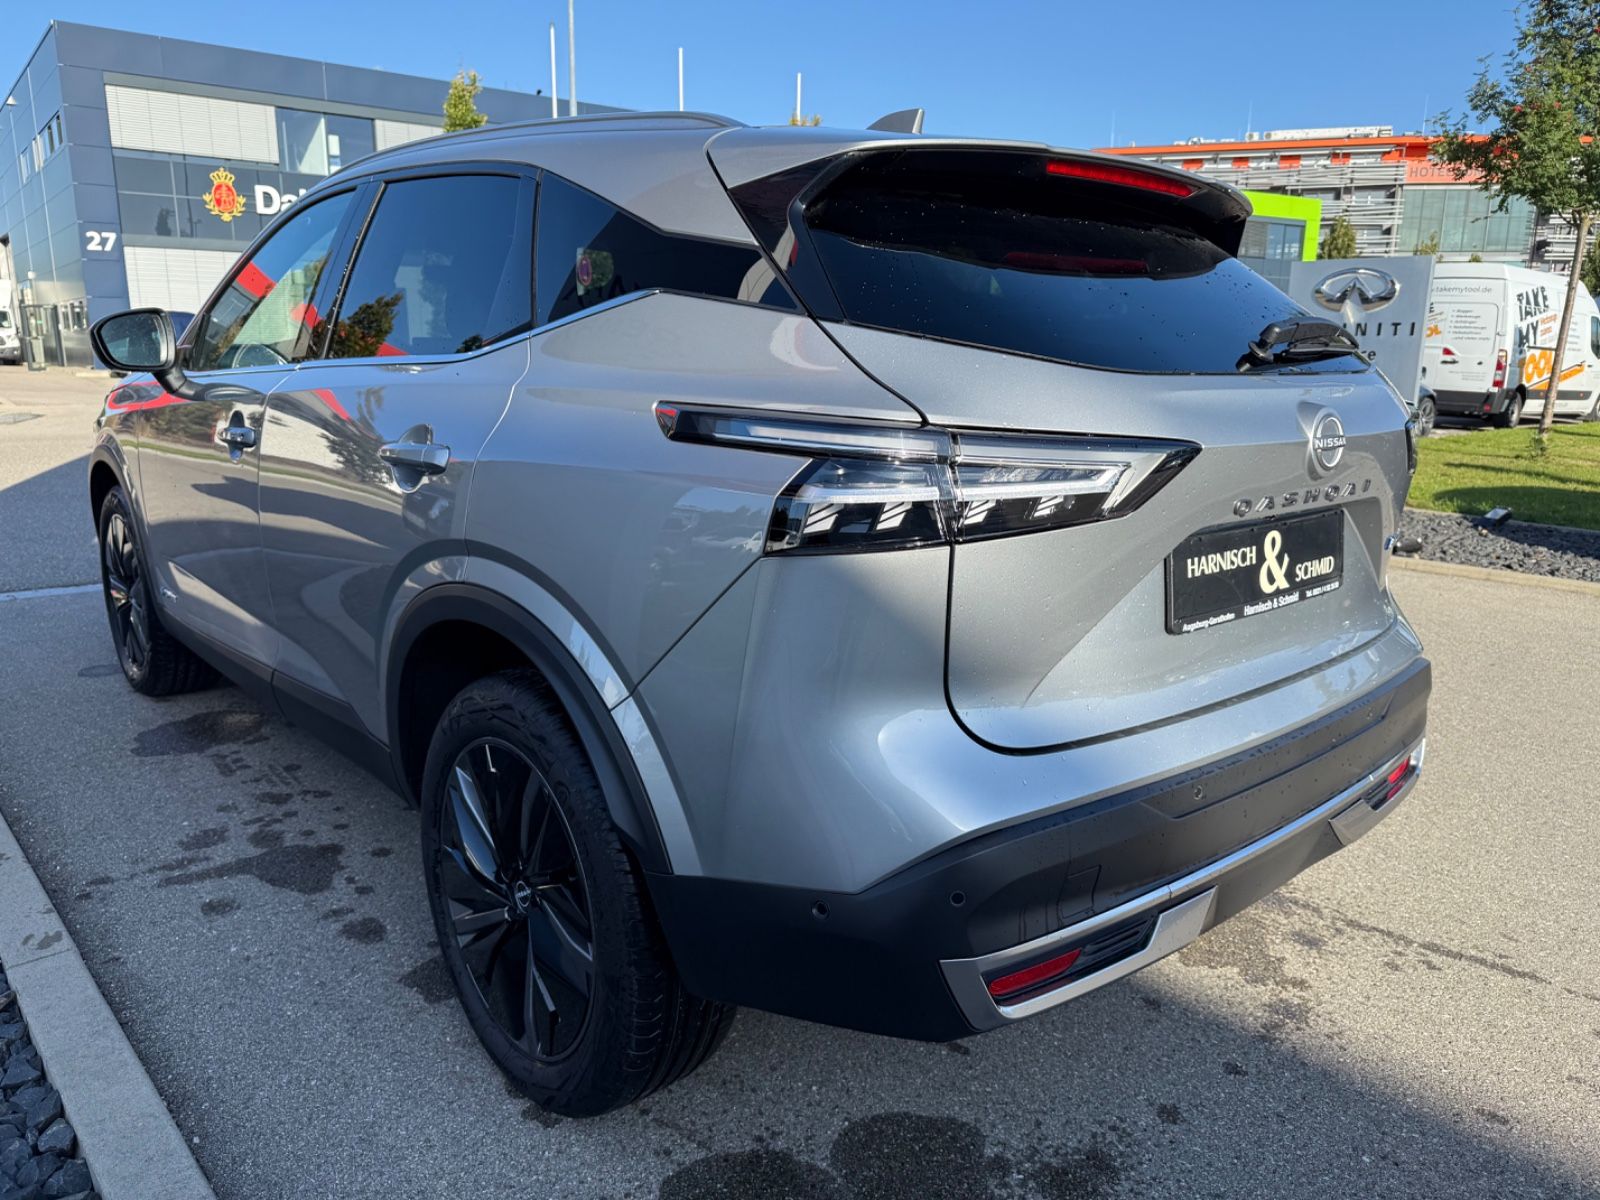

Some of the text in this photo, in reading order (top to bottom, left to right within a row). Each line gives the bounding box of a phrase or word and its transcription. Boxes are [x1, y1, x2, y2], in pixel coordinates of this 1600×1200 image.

[254, 184, 307, 215] Da
[85, 231, 117, 251] 27
[1516, 286, 1549, 322] TAKE
[1519, 319, 1539, 348] MY
[1315, 436, 1347, 449] NISSAN
[1233, 479, 1372, 517] QASHQAI
[1187, 545, 1257, 578] HARNISCH
[1259, 529, 1290, 594] &
[1295, 555, 1335, 582] SCHMID
[1243, 591, 1300, 616] Harnisch & Schmid
